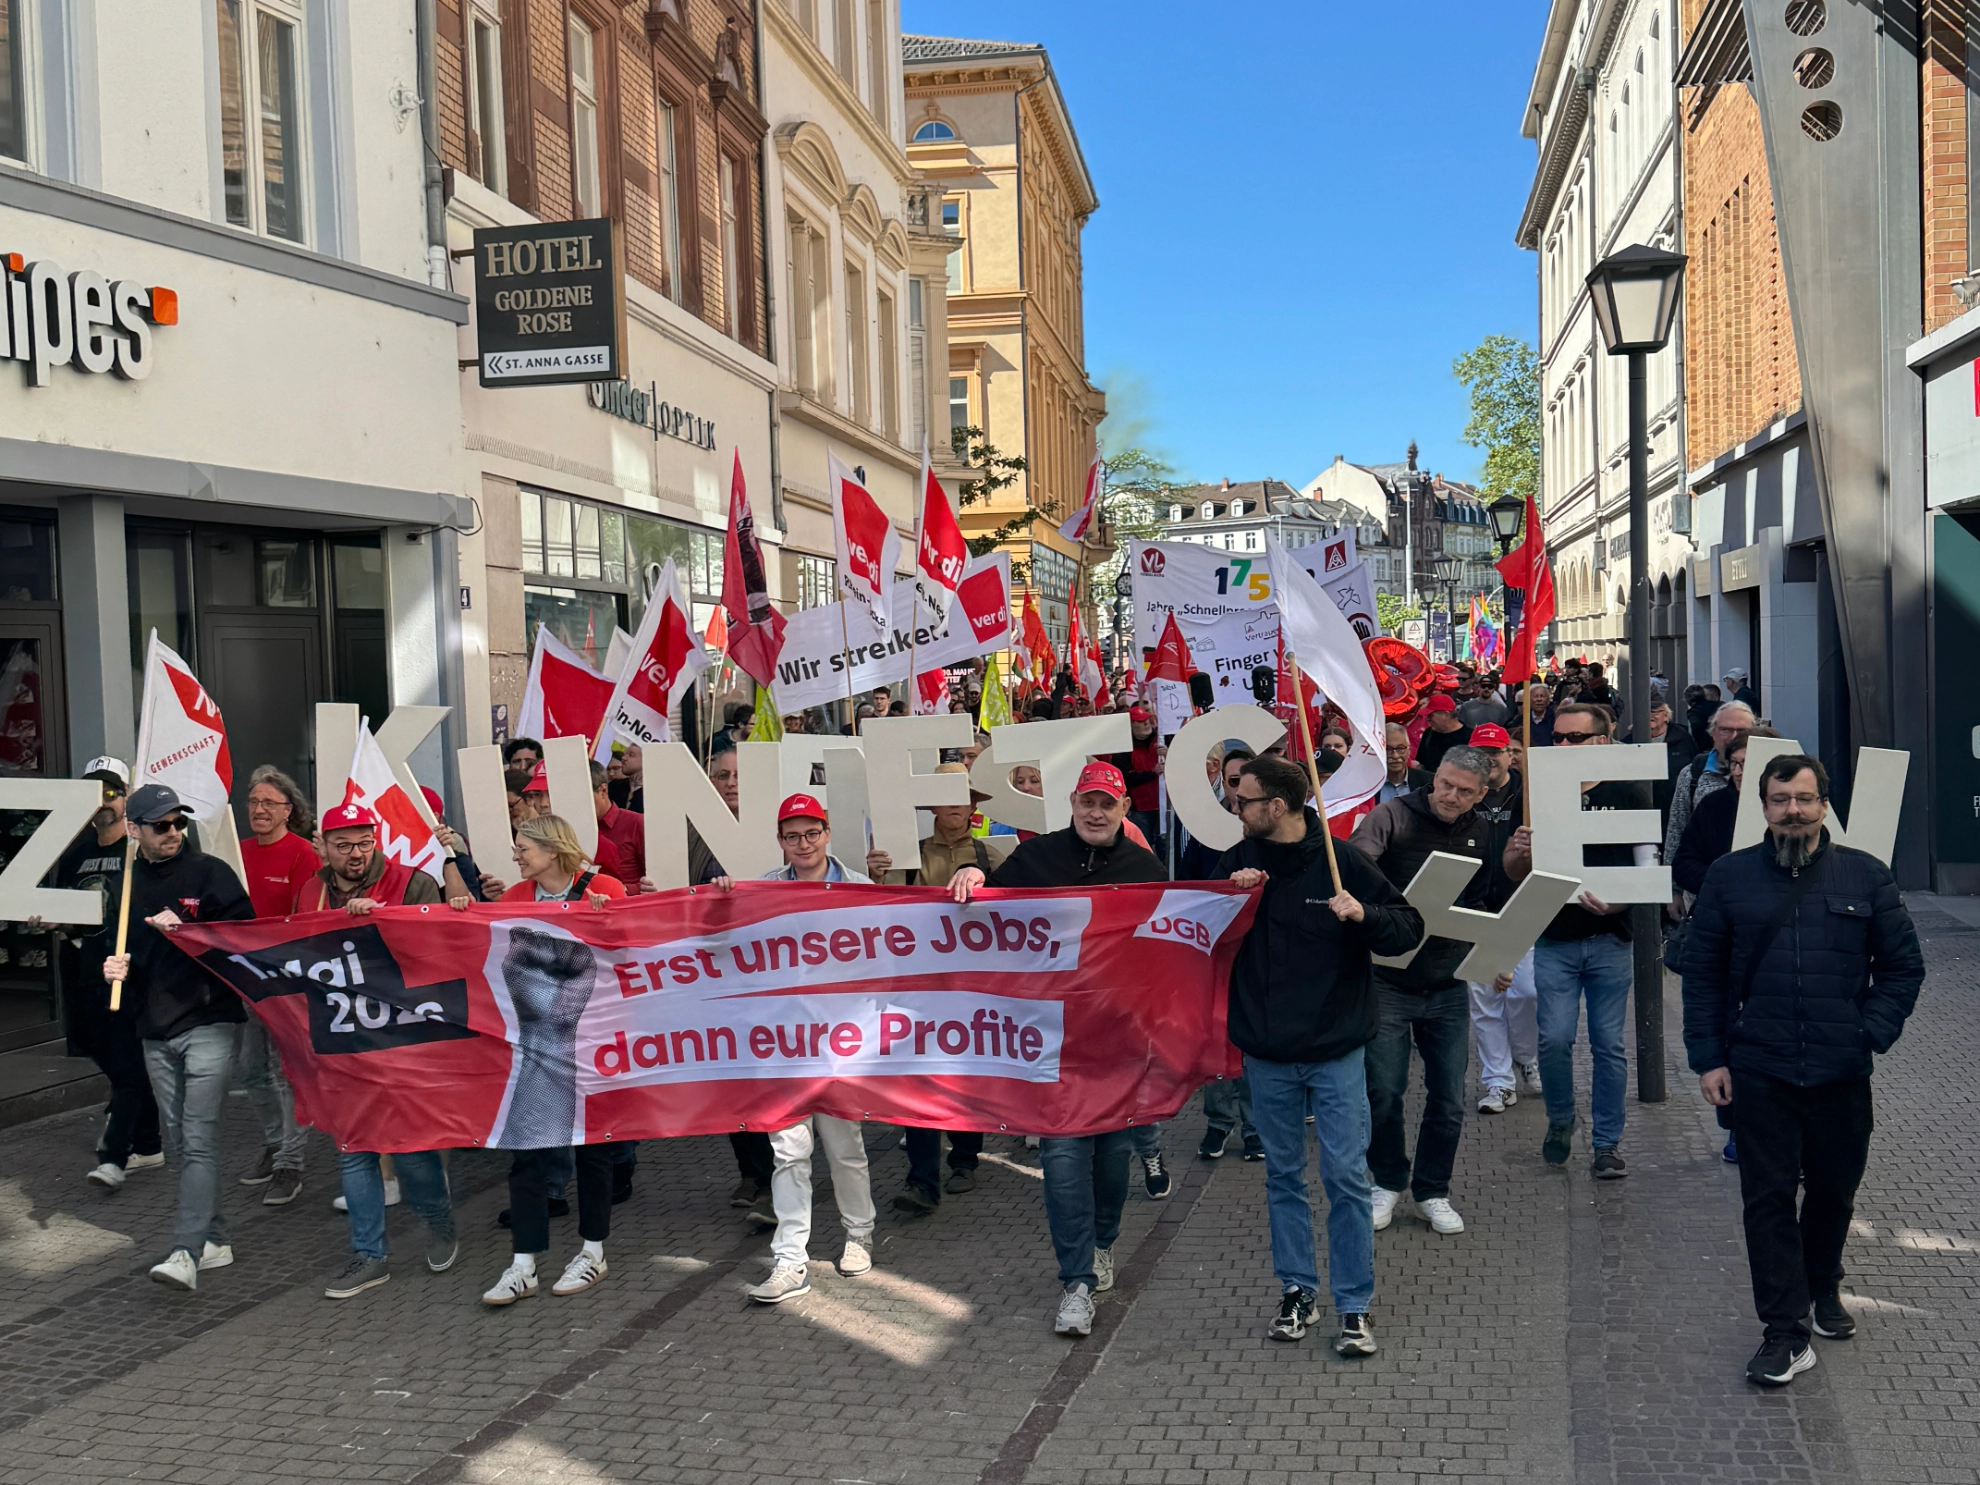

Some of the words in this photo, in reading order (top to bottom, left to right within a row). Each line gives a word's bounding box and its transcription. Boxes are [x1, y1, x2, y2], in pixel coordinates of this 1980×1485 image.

[484, 235, 602, 277] HOTEL
[495, 285, 593, 311] GOLDENE
[0, 252, 152, 387] ipes
[517, 311, 573, 335] ROSE
[505, 359, 522, 370] ST.
[525, 356, 561, 368] ANNA
[565, 353, 604, 366] GASSE
[660, 401, 716, 451] OPTIK
[1215, 559, 1270, 601] 175
[972, 606, 1007, 629] ver.di
[1147, 601, 1175, 612] Jahre
[778, 656, 821, 686] Wir
[1215, 650, 1270, 673] Finger
[150, 735, 216, 774] GEWERKSCHAFT
[1151, 916, 1211, 949] DGB
[279, 940, 365, 987] ai
[613, 948, 723, 998] Erst
[731, 924, 916, 974] unsere
[930, 911, 1061, 958] Jobs,
[594, 1026, 737, 1077] dann
[749, 1021, 863, 1059] eure
[879, 1008, 1043, 1062] Profite
